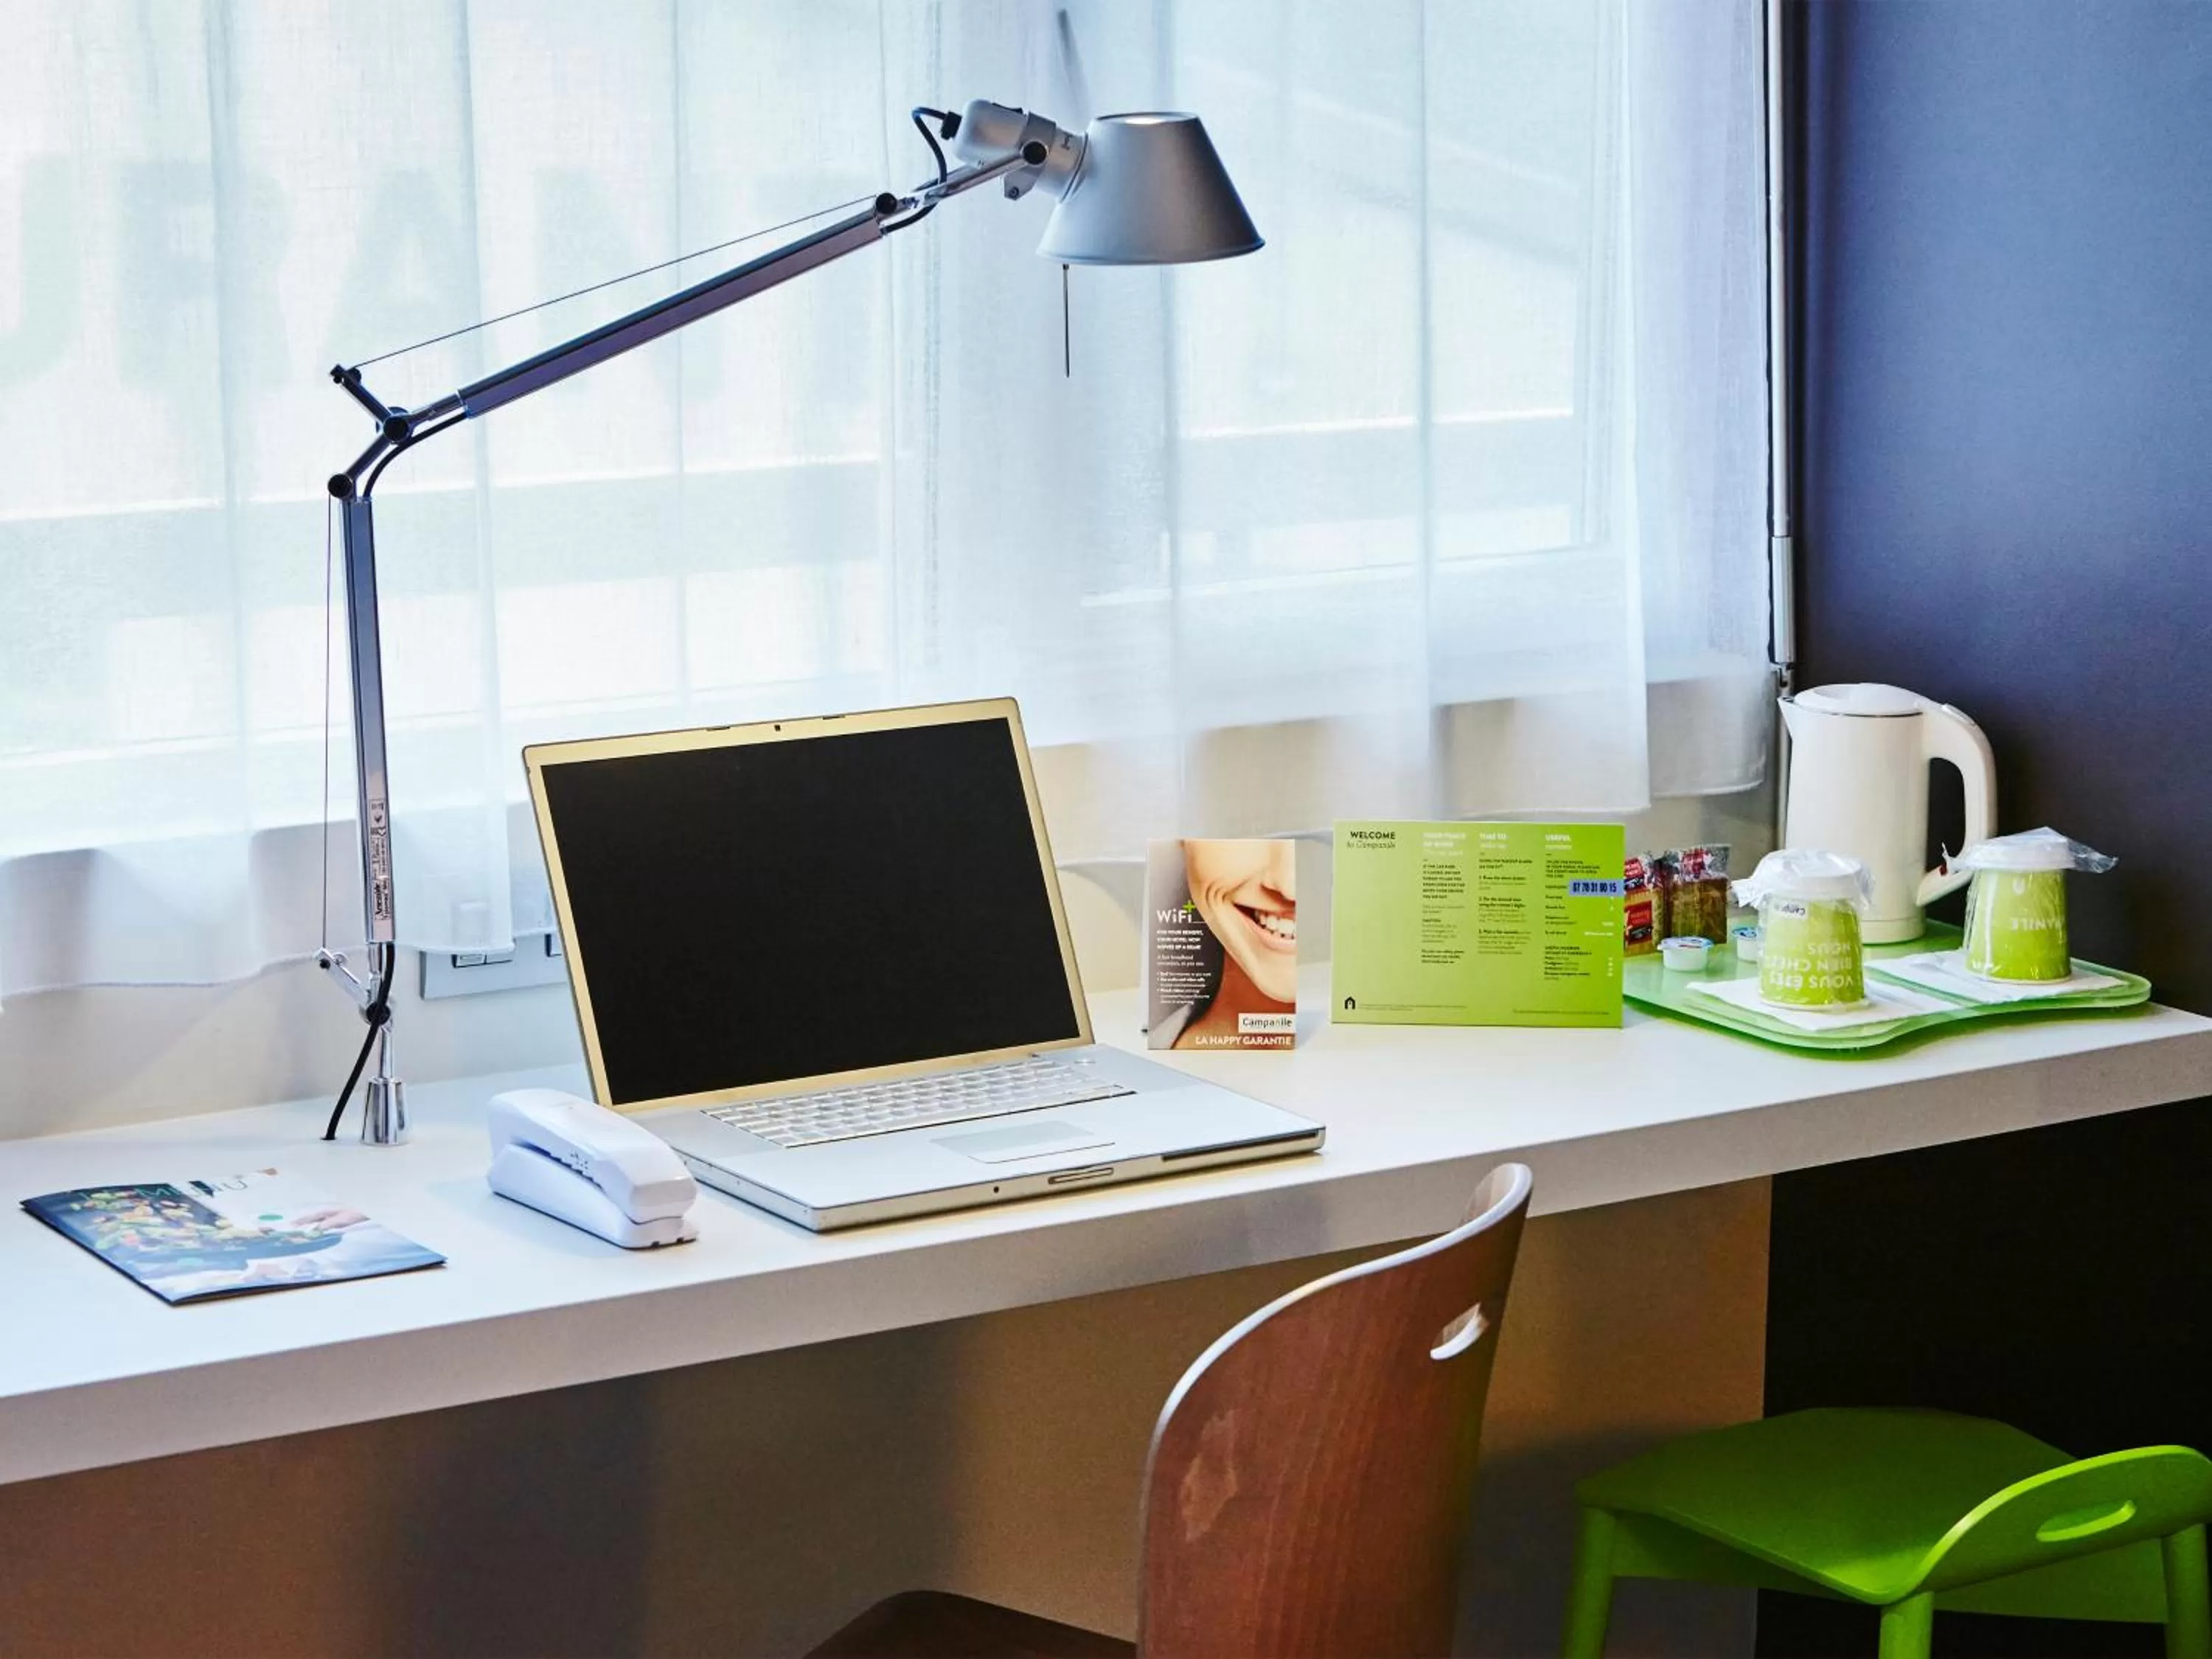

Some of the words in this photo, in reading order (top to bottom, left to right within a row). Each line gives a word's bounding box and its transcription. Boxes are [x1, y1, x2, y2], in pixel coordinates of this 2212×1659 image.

[1350, 831, 1396, 840] WELCOME
[1609, 882, 1617, 893] 15
[1809, 975, 1854, 989] VOUS
[1242, 1018, 1293, 1029] Campanile
[1195, 1036, 1208, 1045] LA
[1210, 1036, 1240, 1046] HAPPY
[1242, 1036, 1292, 1045] GARANTIE
